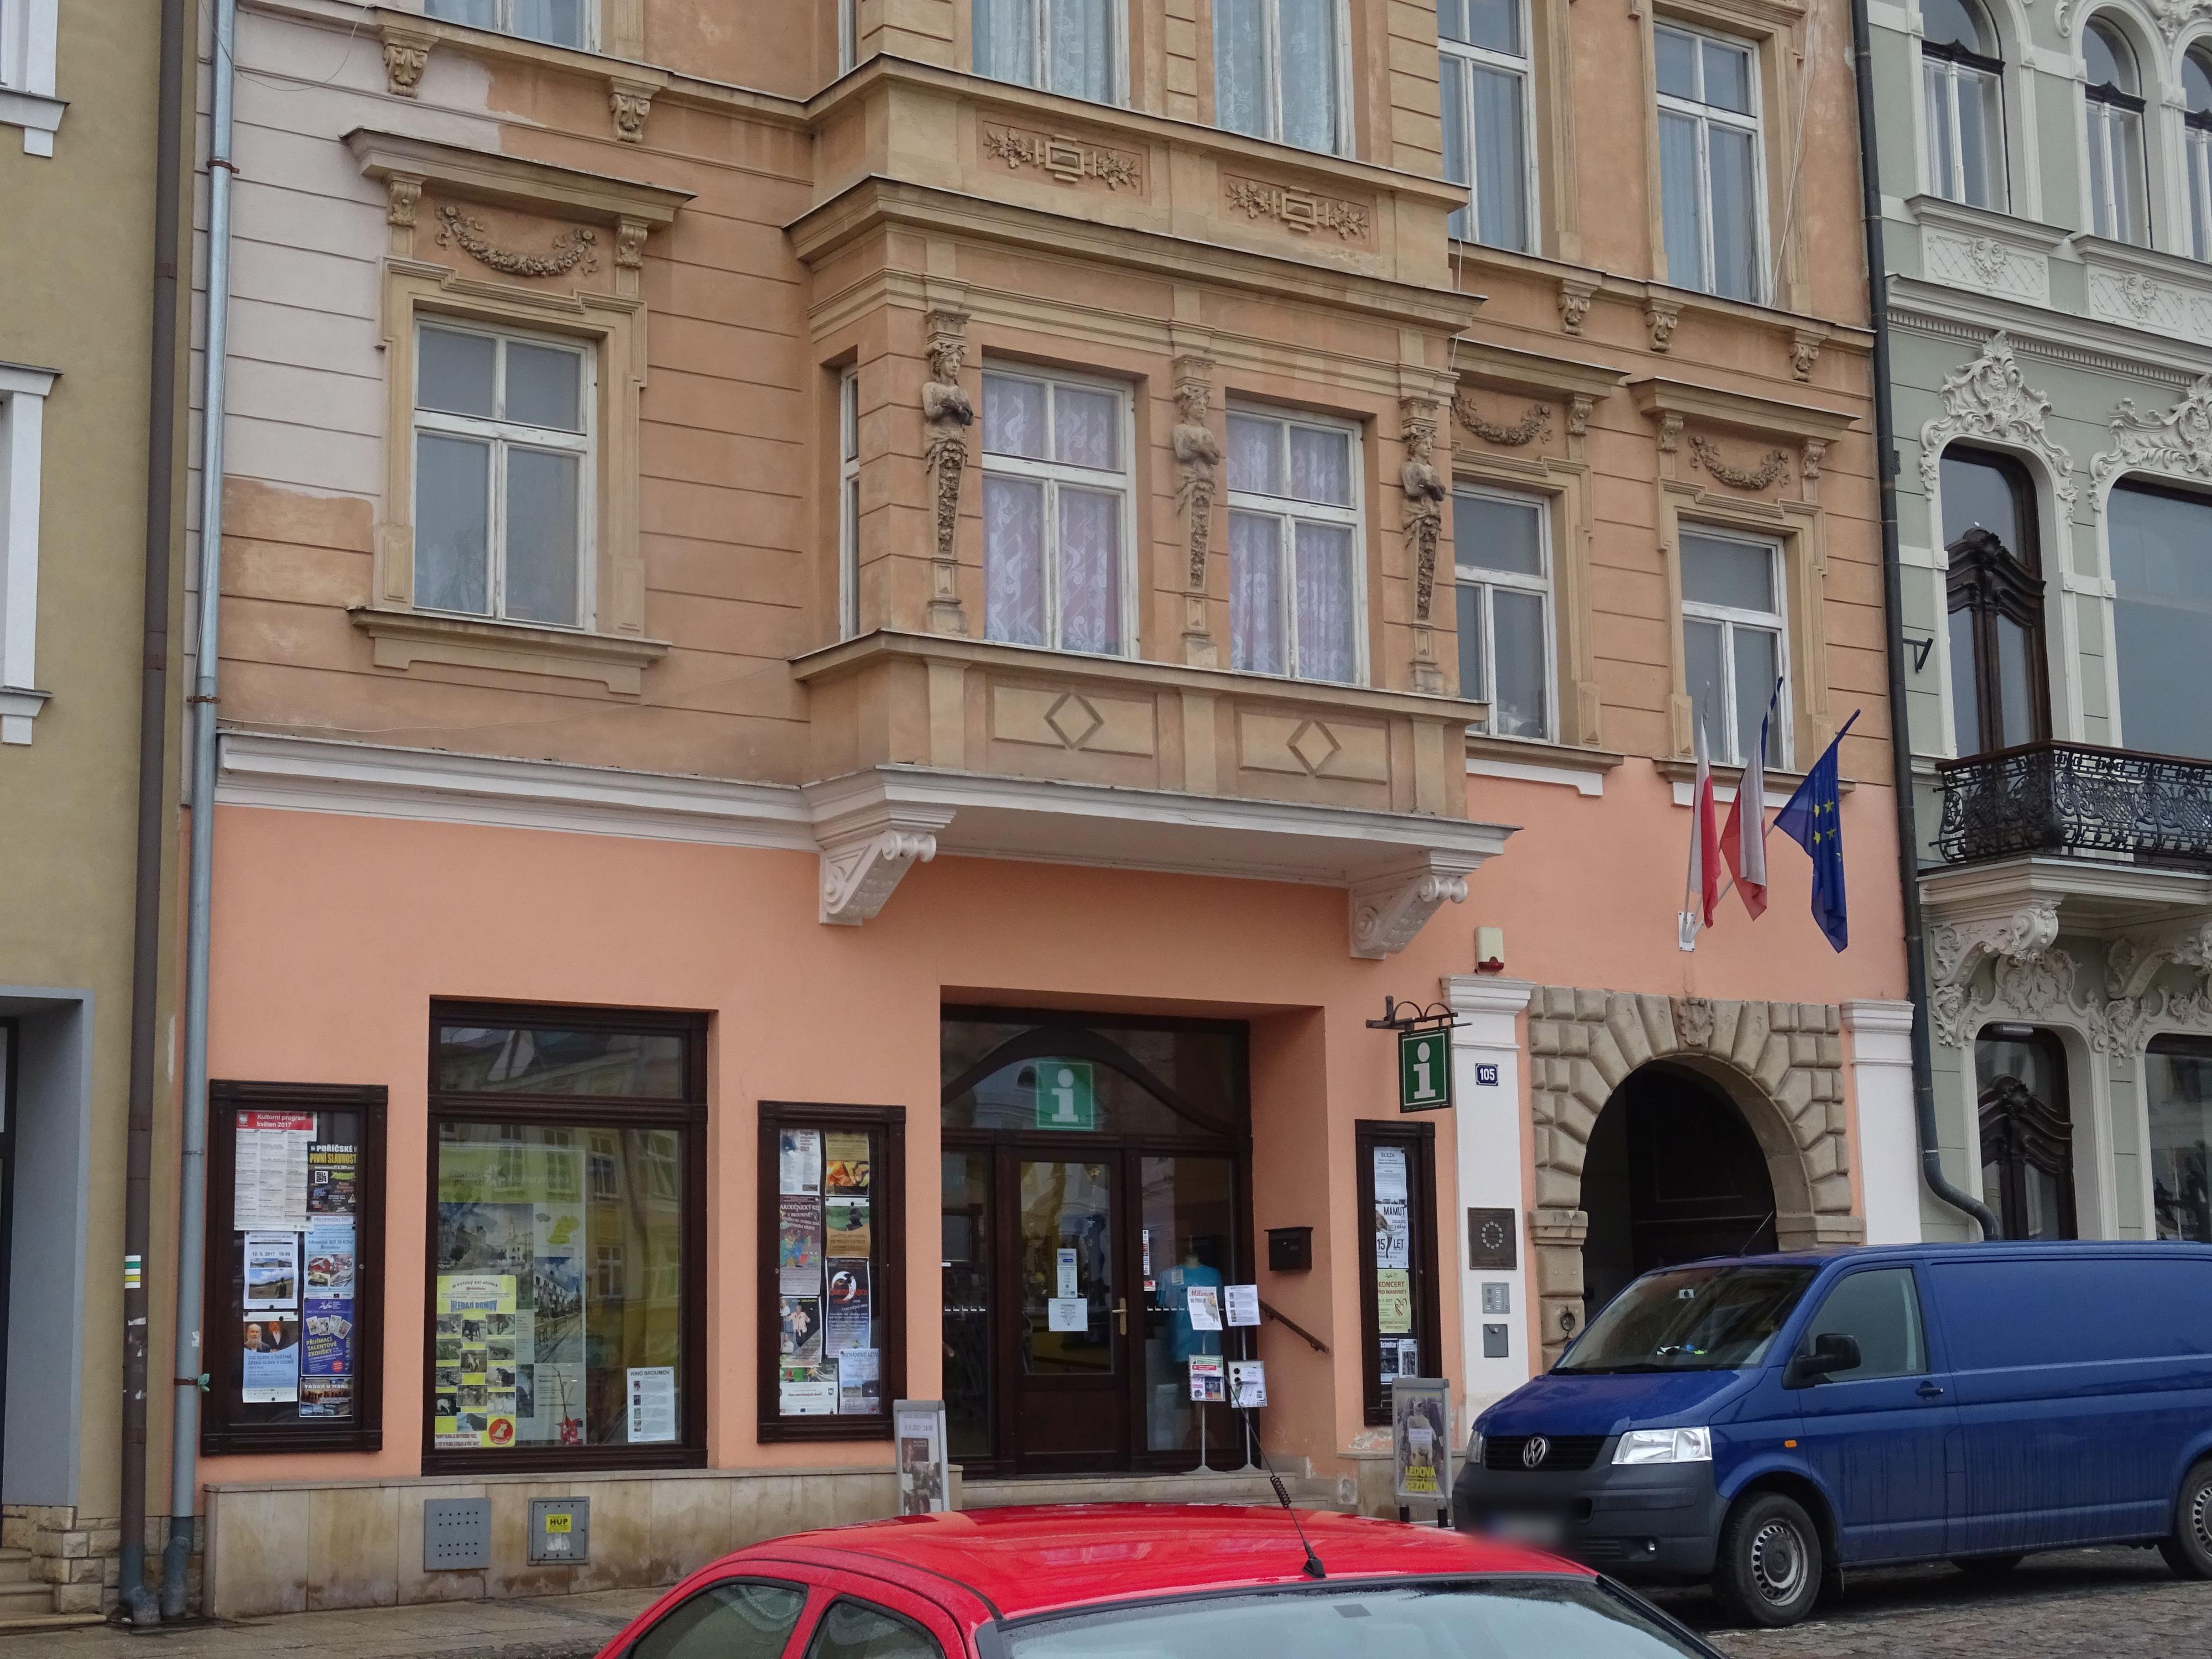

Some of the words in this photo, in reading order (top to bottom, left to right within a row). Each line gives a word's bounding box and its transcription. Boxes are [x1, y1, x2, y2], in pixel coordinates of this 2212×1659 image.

[1479, 1068, 1495, 1081] 105
[1384, 1207, 1405, 1216] MAMUT
[1377, 1239, 1385, 1250] 15
[1394, 1239, 1405, 1248] LET
[475, 1300, 497, 1311] DOMOV
